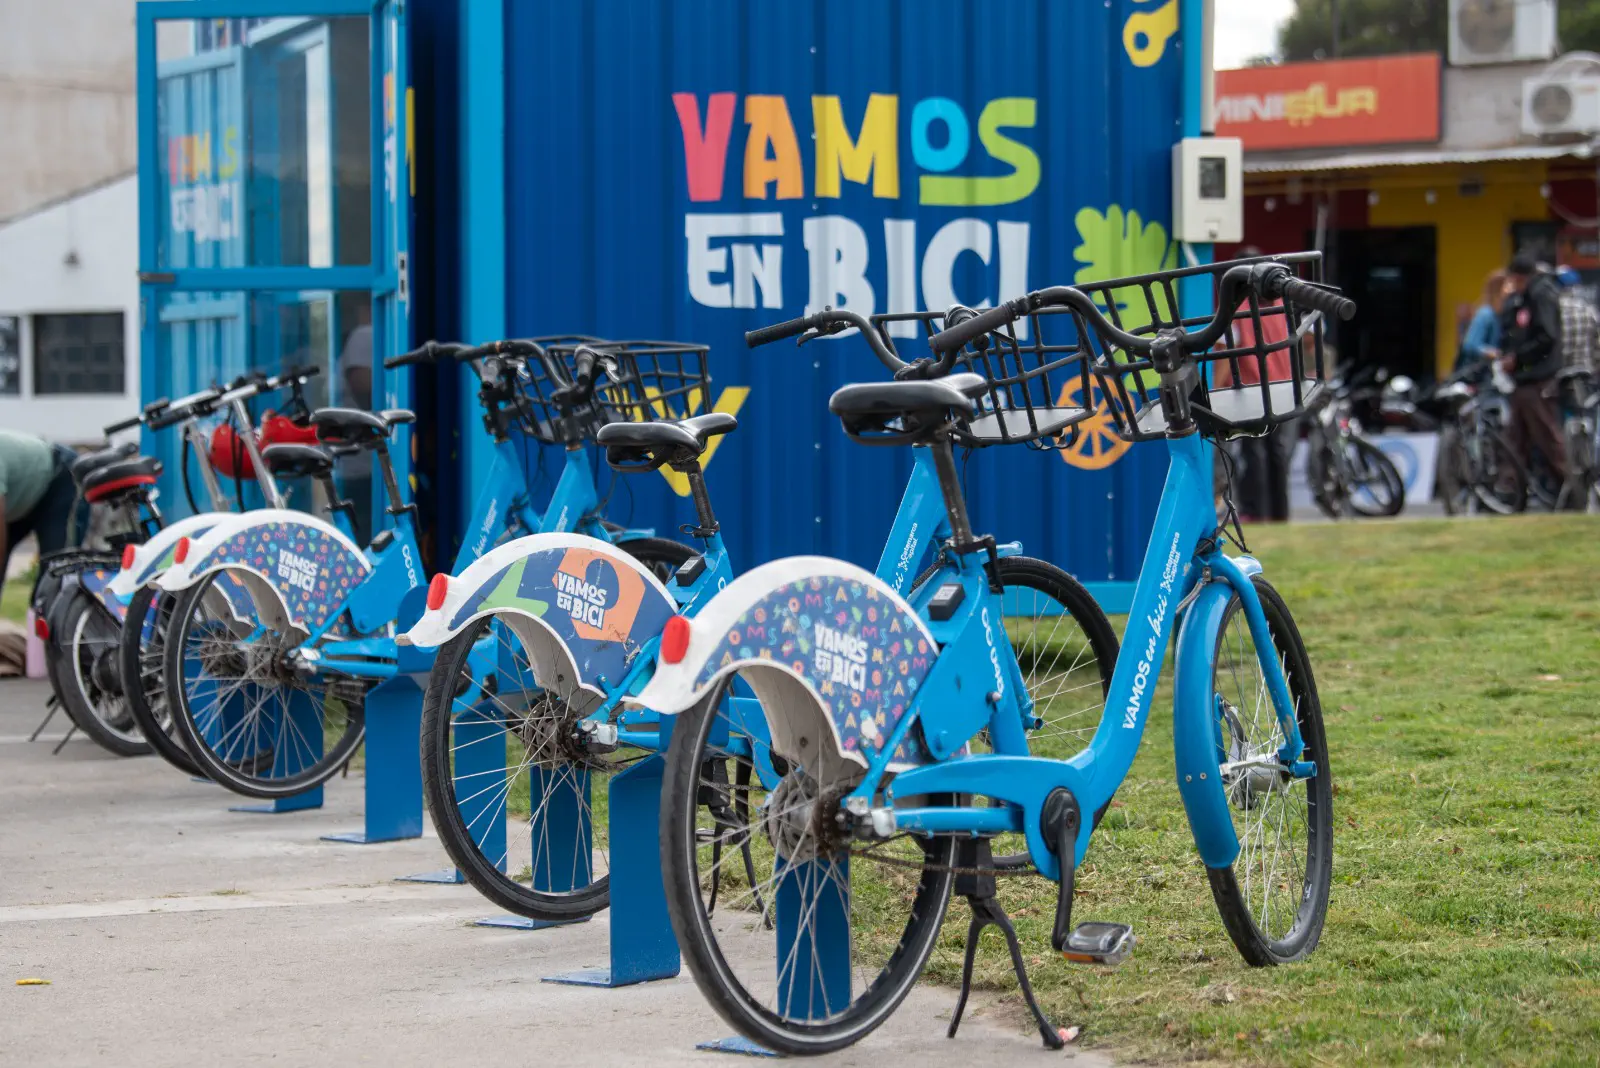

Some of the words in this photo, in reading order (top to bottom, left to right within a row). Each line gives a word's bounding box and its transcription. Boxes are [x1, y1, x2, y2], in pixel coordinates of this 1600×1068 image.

[672, 92, 1042, 206] VAMOS
[685, 212, 784, 309] EN
[803, 215, 1029, 340] BICI
[279, 549, 318, 577] VAMOS
[1163, 532, 1180, 580] Catamarca
[1169, 551, 1181, 583] Capital
[289, 569, 315, 592] BICI
[558, 571, 607, 607] VAMOS
[557, 591, 573, 611] EN
[571, 598, 605, 629] BICI
[1148, 594, 1169, 638] bici
[814, 622, 868, 663] VAMOS
[1145, 636, 1157, 662] en
[832, 655, 866, 692] BICI
[1122, 660, 1151, 729] VAMOS
